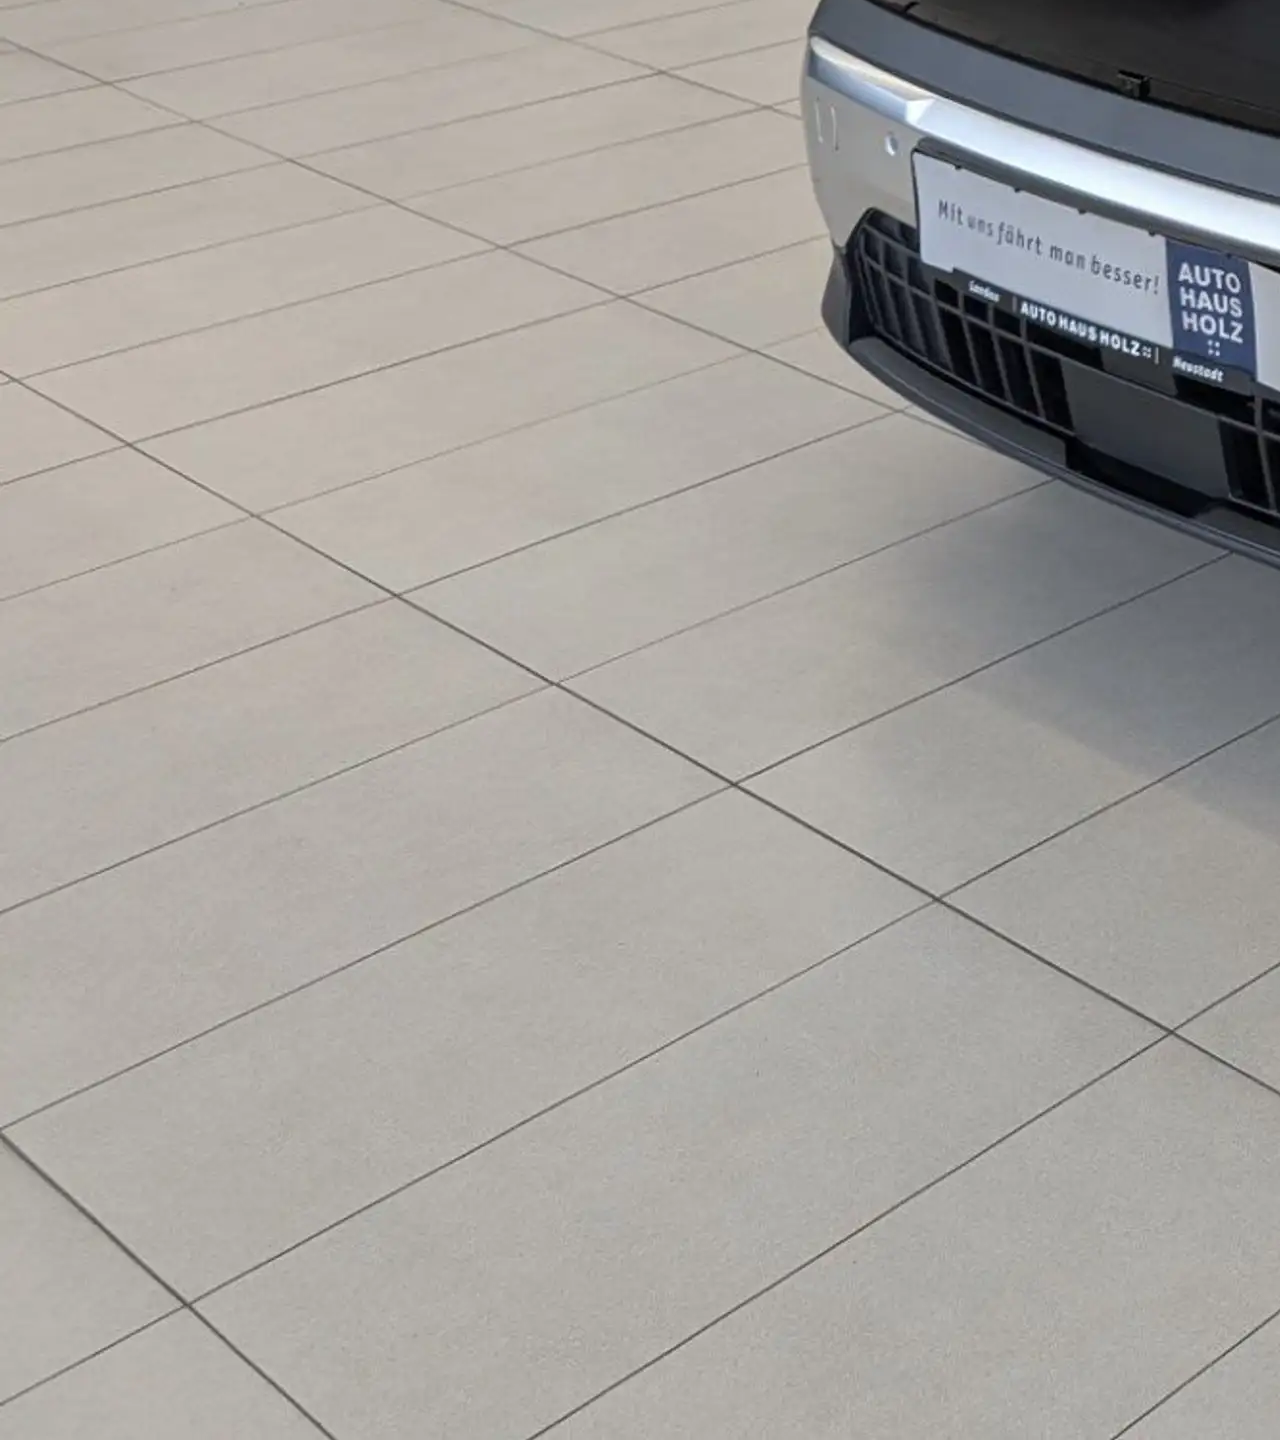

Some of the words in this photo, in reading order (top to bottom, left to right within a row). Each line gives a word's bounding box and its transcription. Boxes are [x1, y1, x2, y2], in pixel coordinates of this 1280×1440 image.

[937, 199, 964, 227] Mit
[967, 214, 994, 238] uns
[996, 220, 1043, 256] fährt
[1049, 243, 1086, 271] man
[1090, 253, 1160, 295] besser!
[1178, 262, 1242, 294] AUTO
[1179, 286, 1243, 318] HAUS
[1020, 301, 1056, 327] AUTO
[1058, 314, 1098, 341] HAUS
[1099, 329, 1141, 357] HOLZ
[1172, 355, 1224, 383] Neustadt
[1181, 310, 1244, 344] HOLZ
